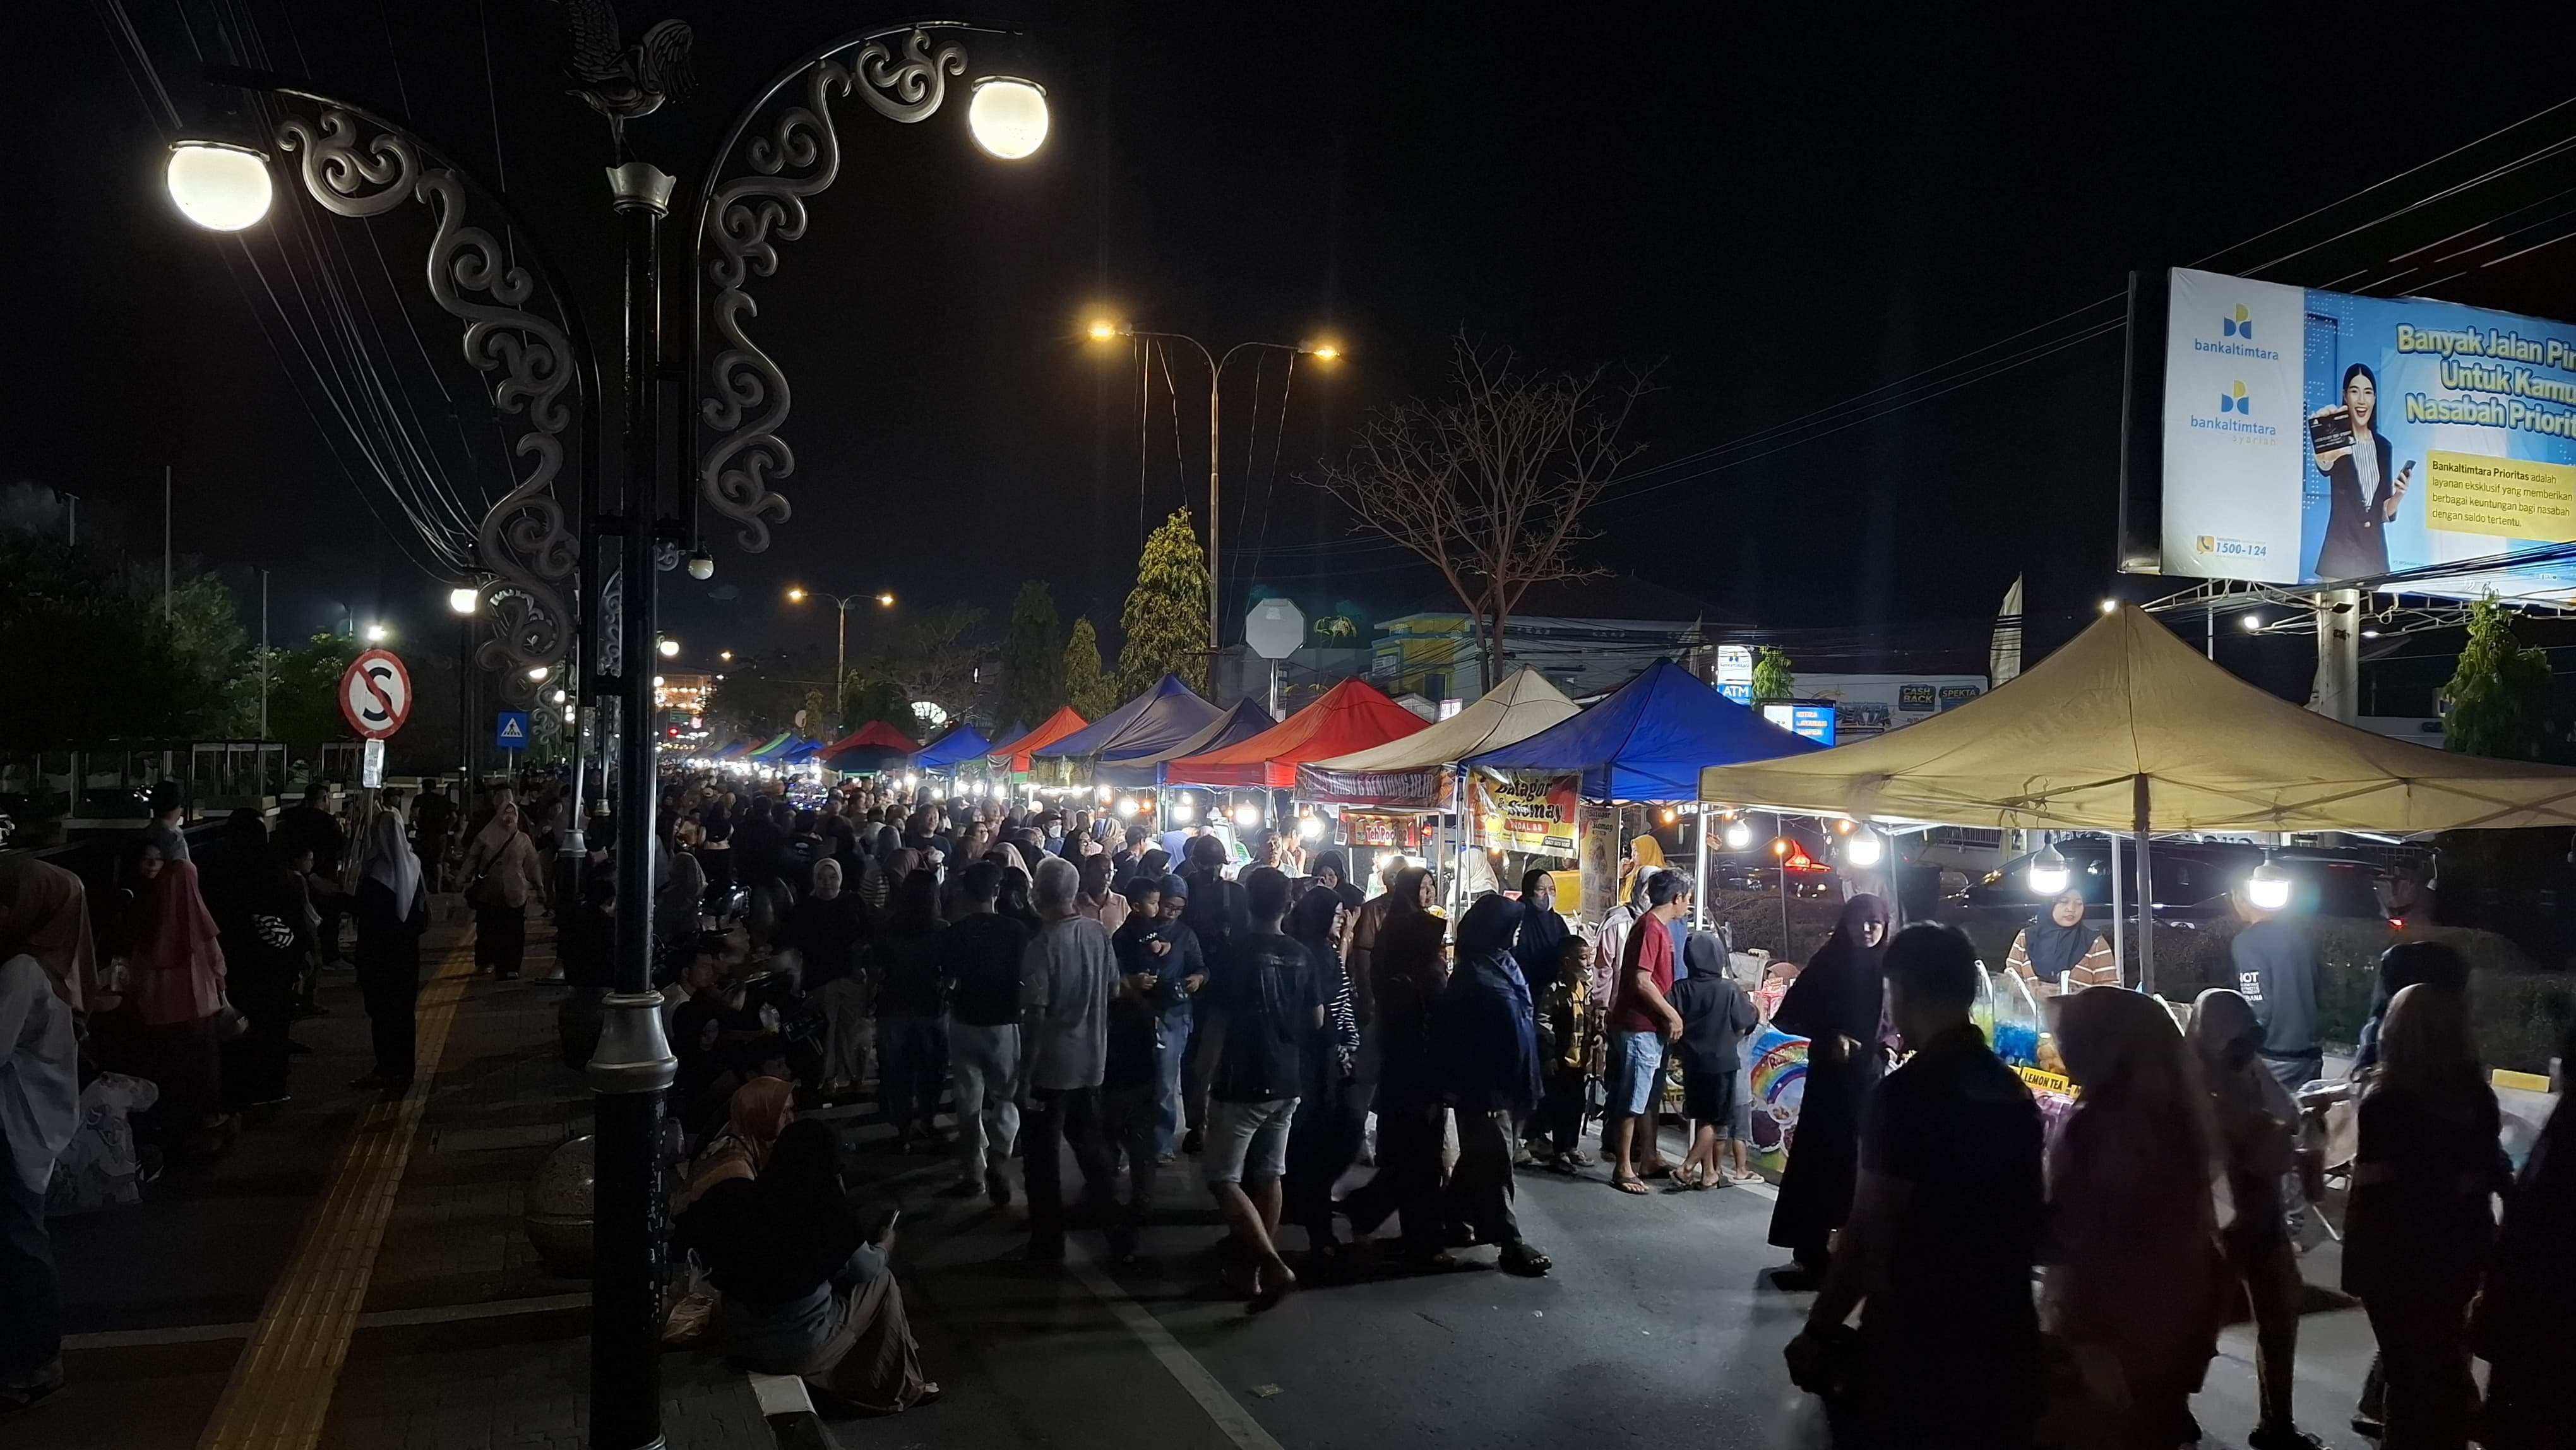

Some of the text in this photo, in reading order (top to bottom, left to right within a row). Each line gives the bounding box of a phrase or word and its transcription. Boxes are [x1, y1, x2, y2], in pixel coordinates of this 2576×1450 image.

[2195, 339, 2279, 360] bankaltimtara
[2397, 324, 2484, 357] Banyak
[2486, 328, 2543, 364] Jalan
[2441, 359, 2576, 405] Untuk Kamu
[2406, 393, 2507, 428] Nasabah
[2191, 415, 2276, 435] bankaltimtara
[2433, 461, 2556, 484] Bankaltimtara Prioritas adalah
[2433, 477, 2573, 501] layanan eksklusif yang memberikan
[2432, 493, 2570, 517] berbagai keuntungan bagi nasabah
[2432, 509, 2522, 527] dengan saldo tertentu.
[2217, 542, 2267, 556] 1500-124
[1723, 685, 1749, 698] ATM
[1903, 687, 1931, 695] CASH
[1903, 695, 1933, 704] BACK
[1942, 689, 1976, 698] SPEKTA
[1495, 779, 1553, 802] Batagor
[1507, 800, 1563, 824] Siomay
[1366, 826, 1379, 841] Teh
[2024, 1072, 2063, 1091] LEMON TEA
